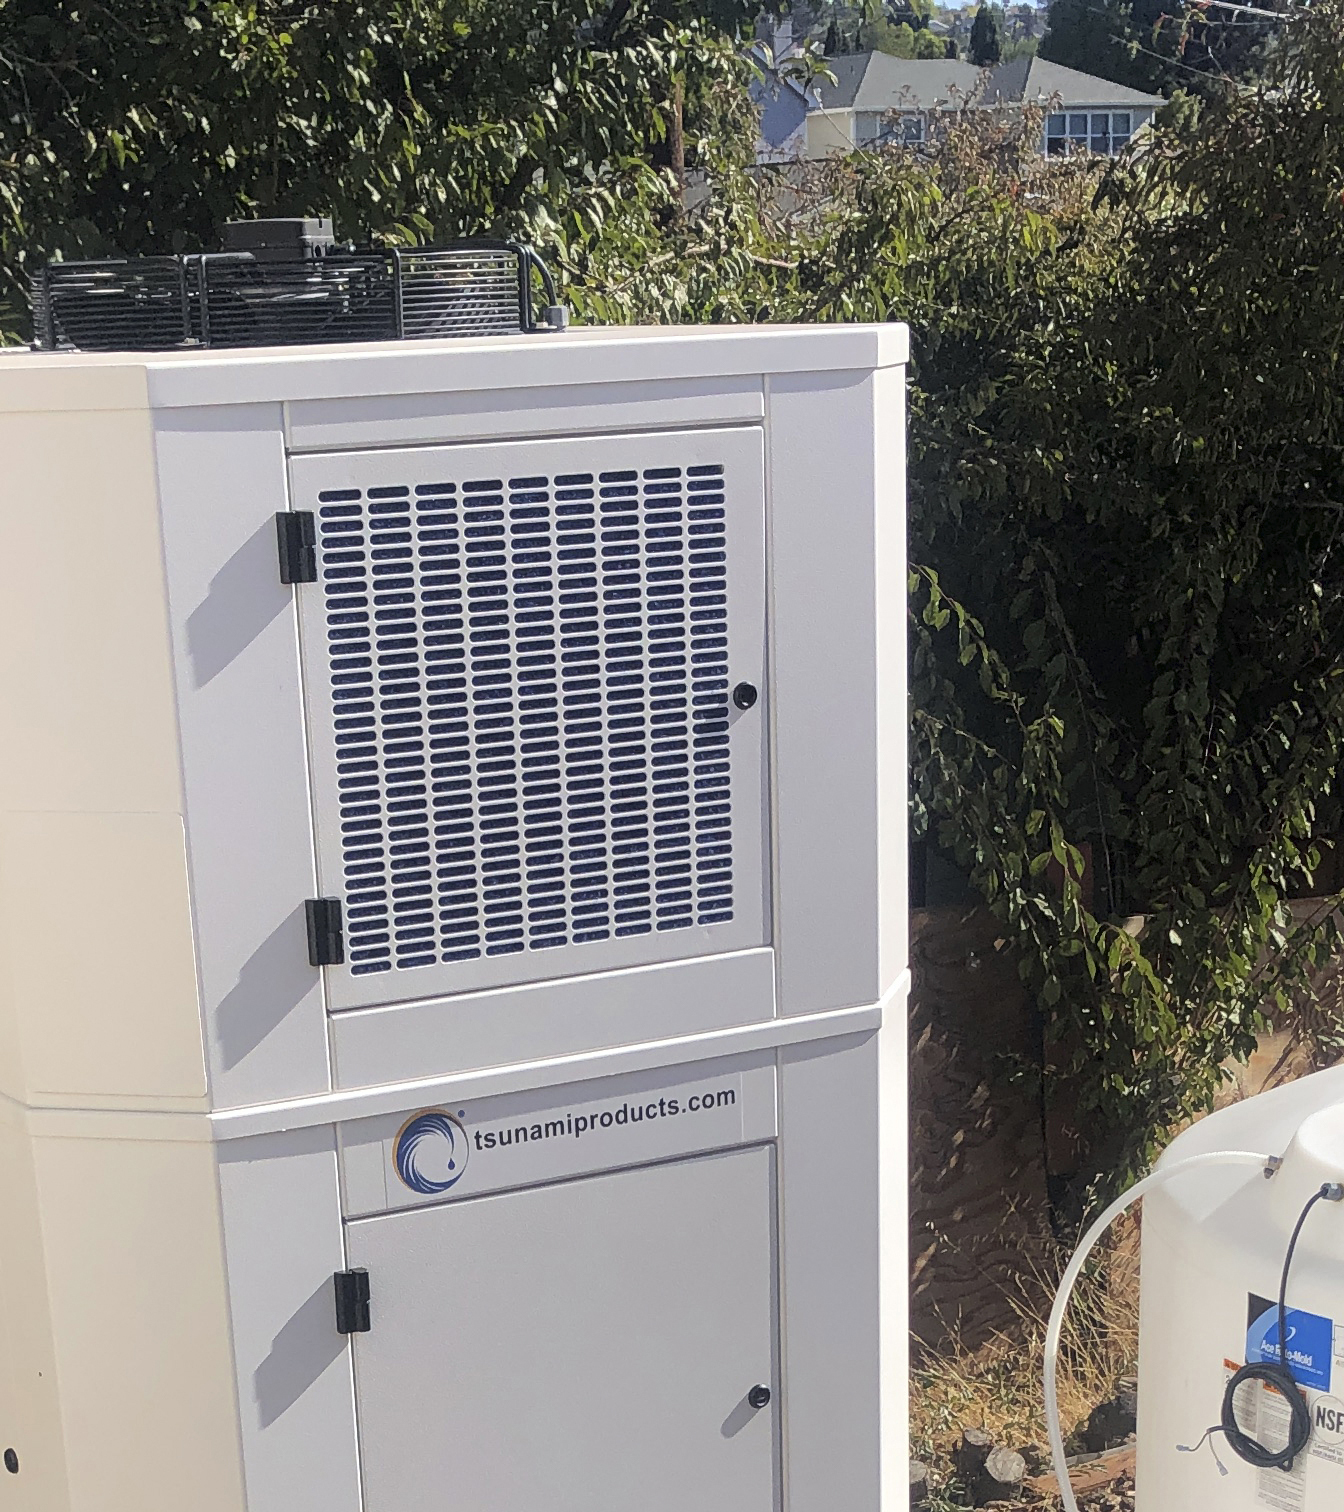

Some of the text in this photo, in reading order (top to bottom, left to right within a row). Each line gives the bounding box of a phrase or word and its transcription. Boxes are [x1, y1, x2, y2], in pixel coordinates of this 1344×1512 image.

[474, 1088, 736, 1151] tsunamiproducts.com
[1261, 1340, 1274, 1354] Ace
[1316, 1405, 1344, 1434] NSF
